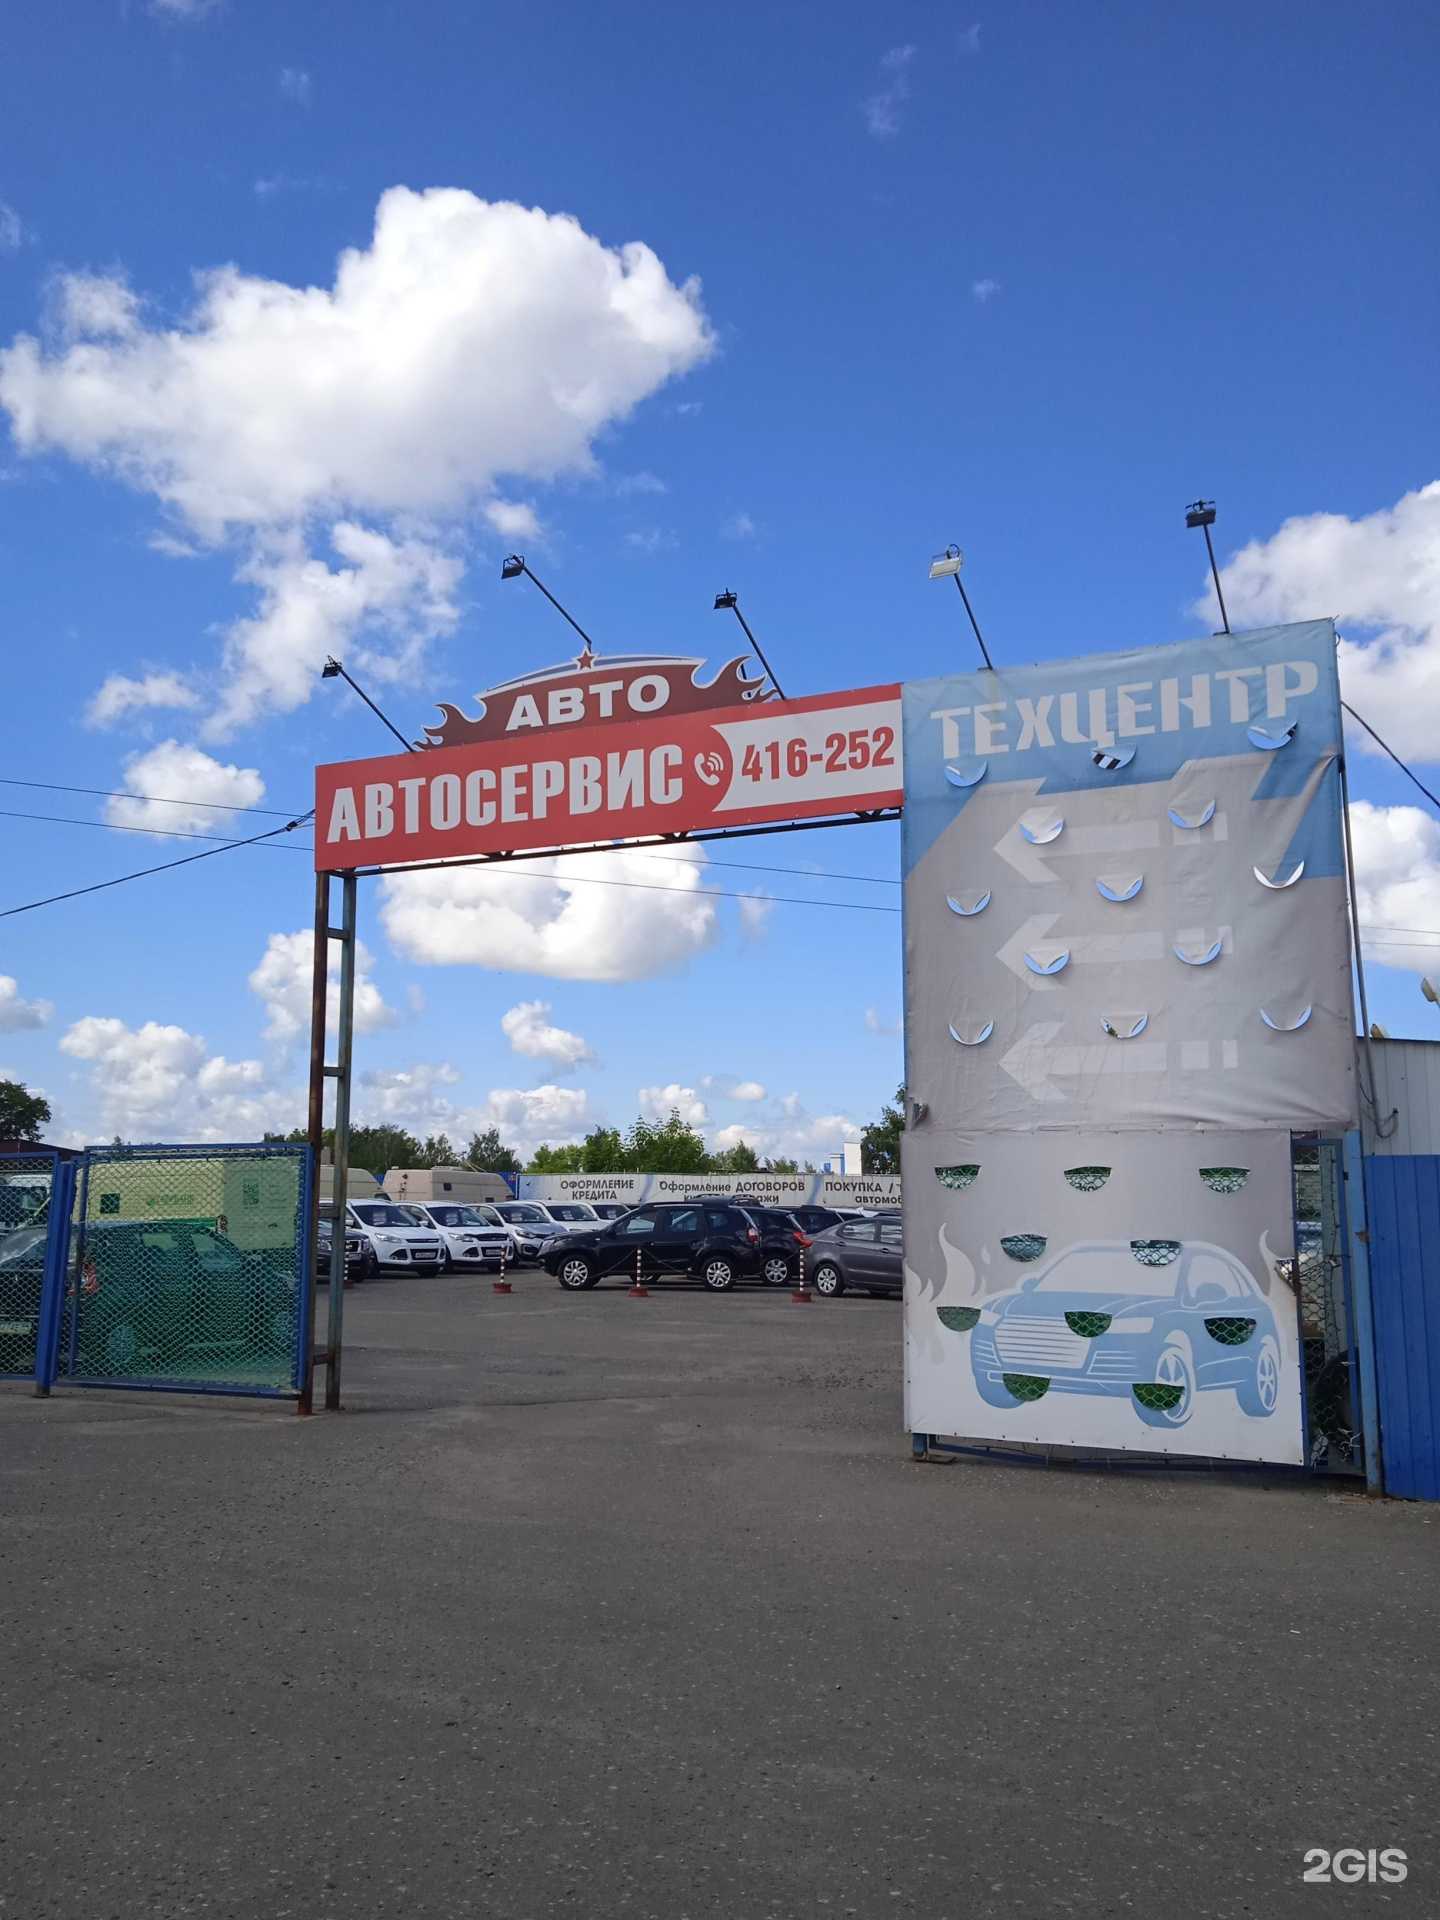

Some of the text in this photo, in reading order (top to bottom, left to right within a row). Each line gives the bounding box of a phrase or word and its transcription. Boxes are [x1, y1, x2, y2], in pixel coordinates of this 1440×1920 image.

[505, 674, 670, 731] АВТО
[930, 660, 1319, 759] ТЕХЦЕНТР
[741, 726, 895, 783] 416-252
[326, 744, 683, 843] АВТОСЕРВИС
[560, 1179, 634, 1190] ОФОРМЛЕНИЕ
[572, 1190, 617, 1201] КРЕДИТА
[659, 1180, 805, 1193] Оформление ДОГОВОРОВ
[825, 1181, 883, 1193] ПОКУПКА
